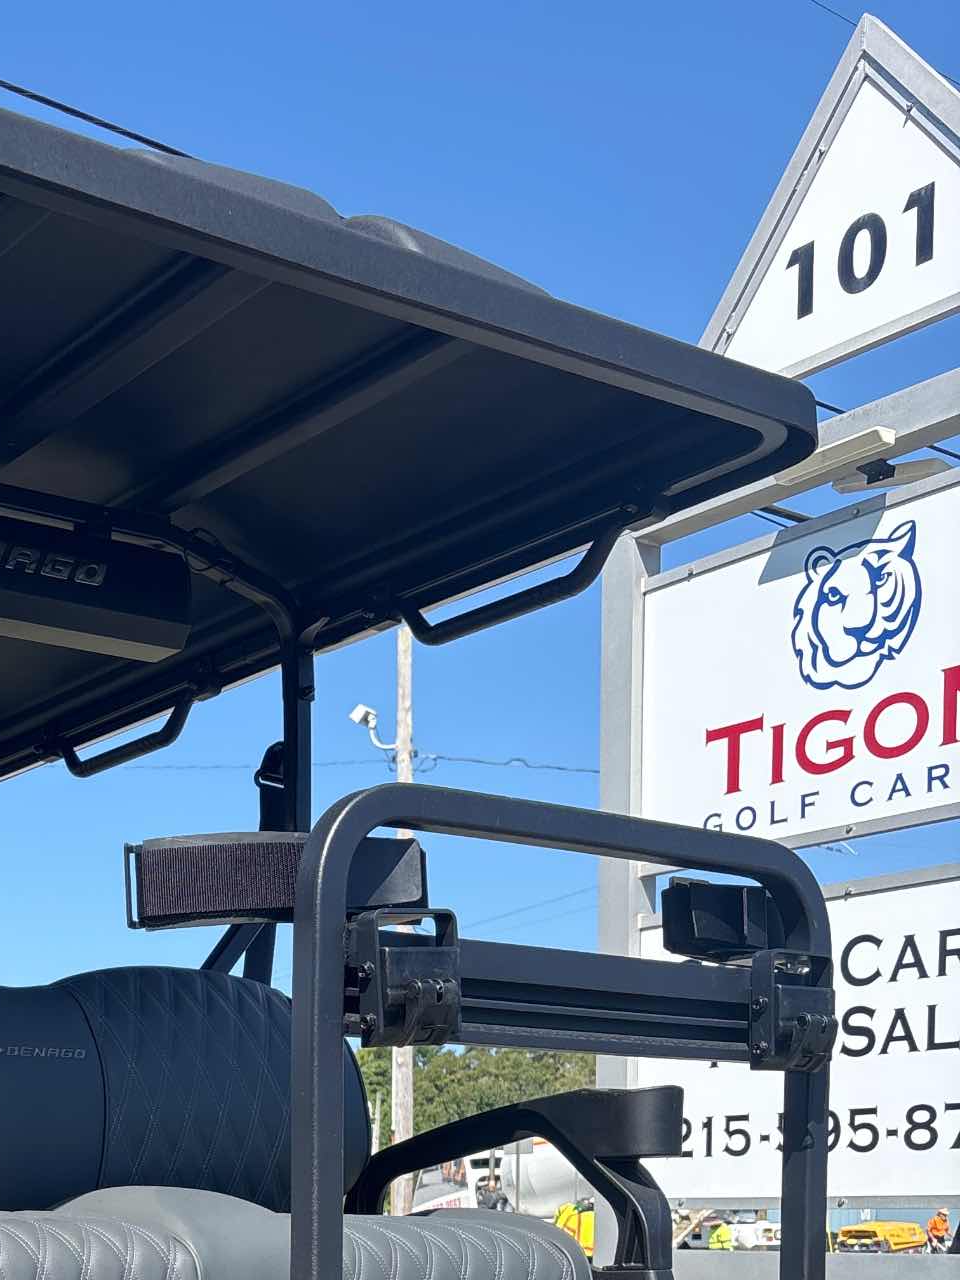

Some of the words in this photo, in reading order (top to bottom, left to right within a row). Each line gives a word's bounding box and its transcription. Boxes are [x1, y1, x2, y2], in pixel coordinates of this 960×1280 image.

[785, 181, 935, 320] 101
[703, 791, 820, 833] GOLF
[850, 763, 950, 808] CAR
[6, 1046, 86, 1058] DENAGO
